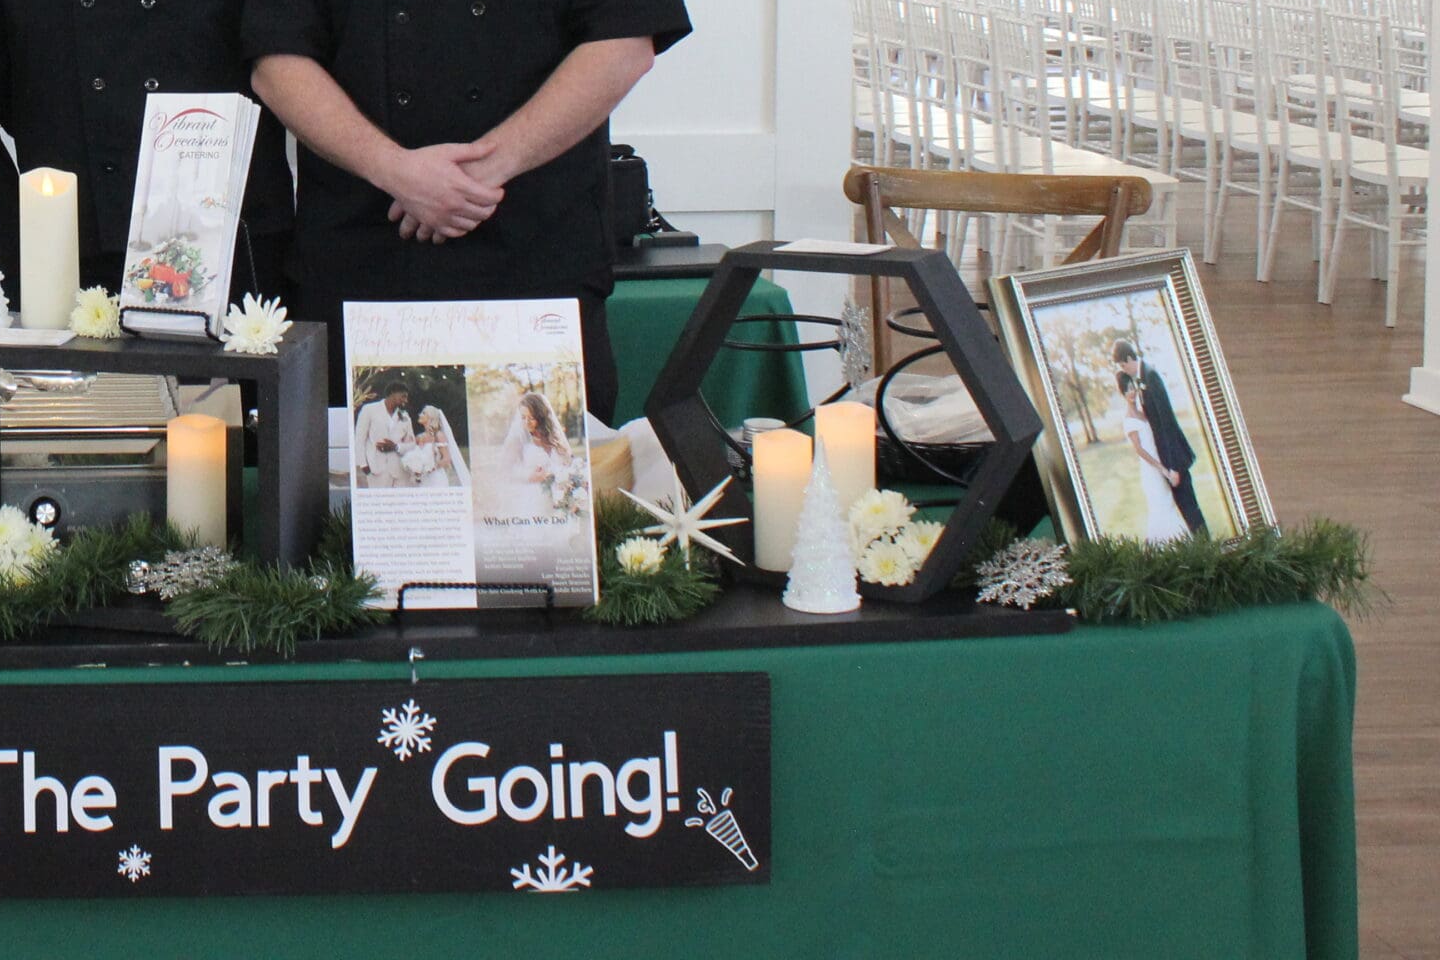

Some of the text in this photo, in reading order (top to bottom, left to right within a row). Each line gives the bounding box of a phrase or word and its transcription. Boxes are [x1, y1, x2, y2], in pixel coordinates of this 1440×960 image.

[149, 110, 222, 134] Vibrant
[154, 131, 229, 152] Occasions
[179, 151, 220, 160] CATERING
[483, 515, 509, 527] What
[511, 515, 530, 526] Can
[532, 514, 549, 526] We
[159, 744, 378, 849] Party
[431, 730, 681, 838] Going!
